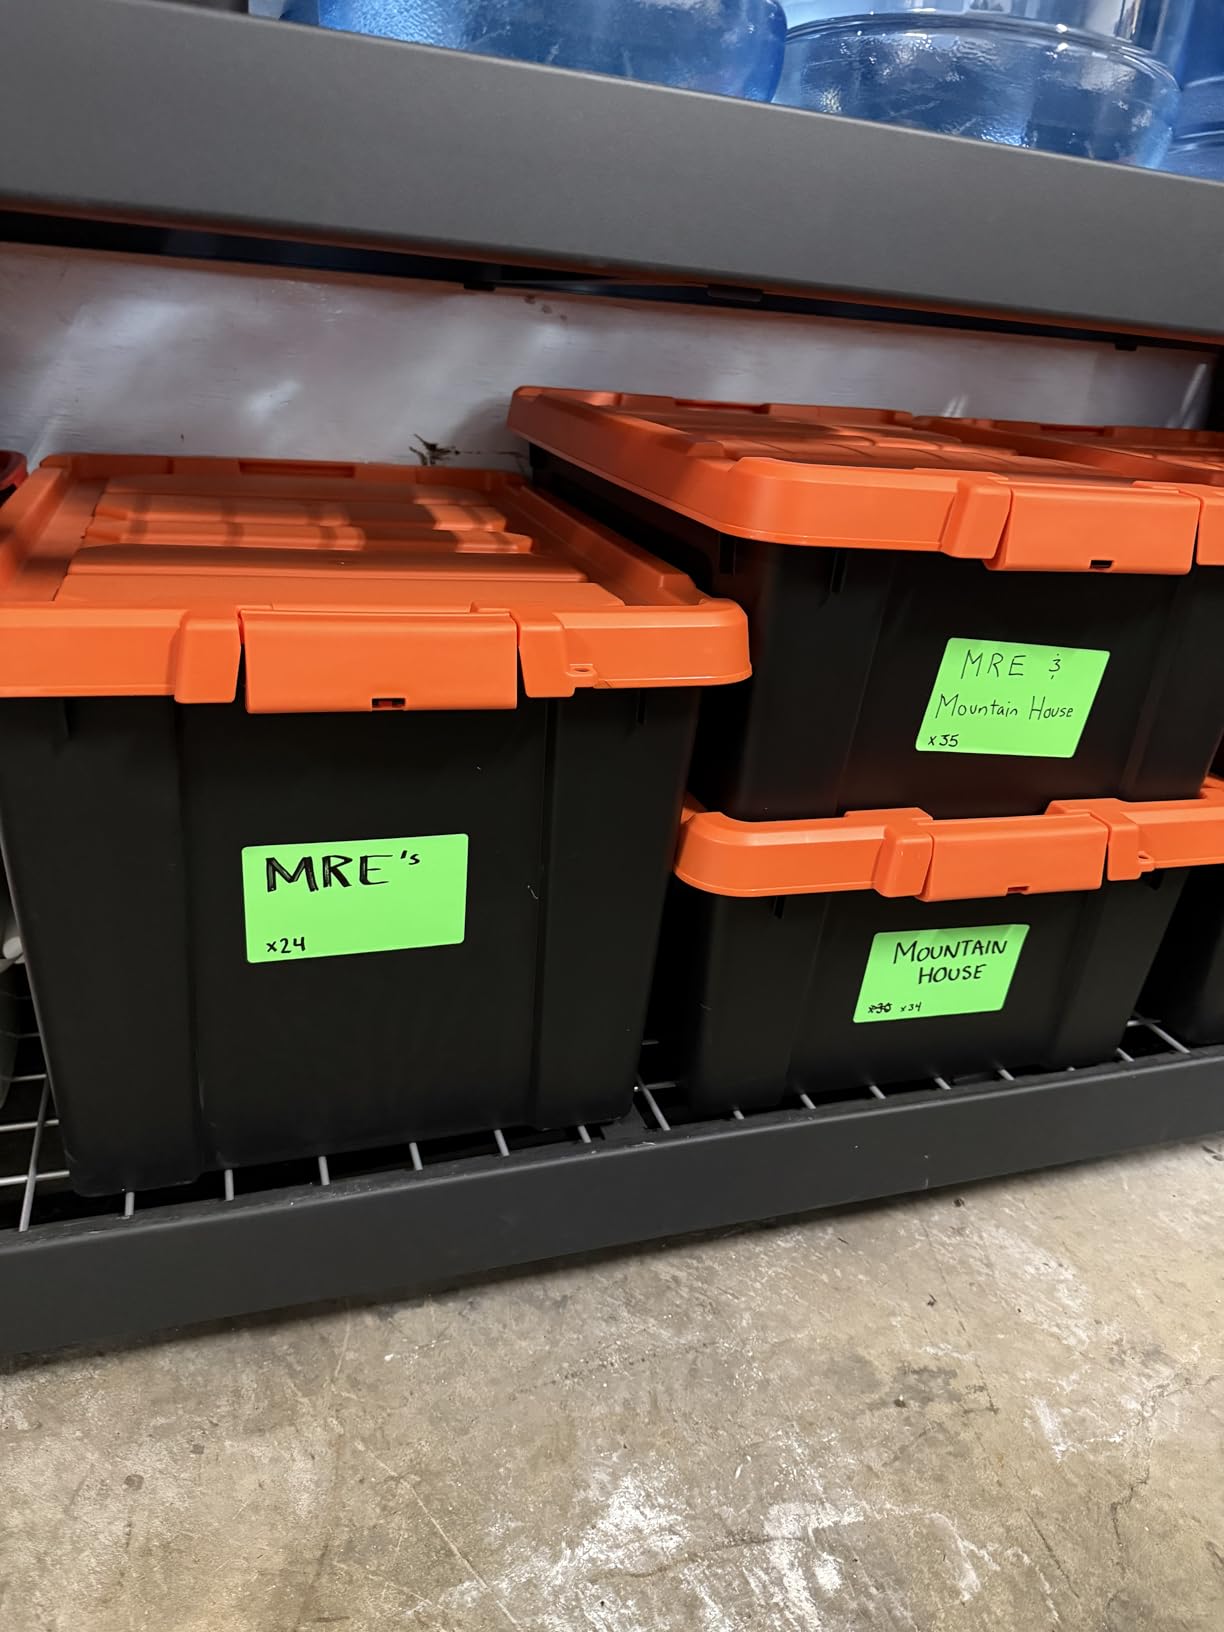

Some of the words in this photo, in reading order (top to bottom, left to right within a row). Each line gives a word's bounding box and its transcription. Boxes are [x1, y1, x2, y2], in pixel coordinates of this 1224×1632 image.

[960, 649, 1026, 680] MRE
[935, 693, 1018, 719] Mountain
[1028, 696, 1074, 721] House
[265, 850, 421, 893] MRE's
[266, 936, 306, 954] x24
[893, 939, 1008, 965] MOUNTAIN
[918, 963, 987, 985] HOUSE
